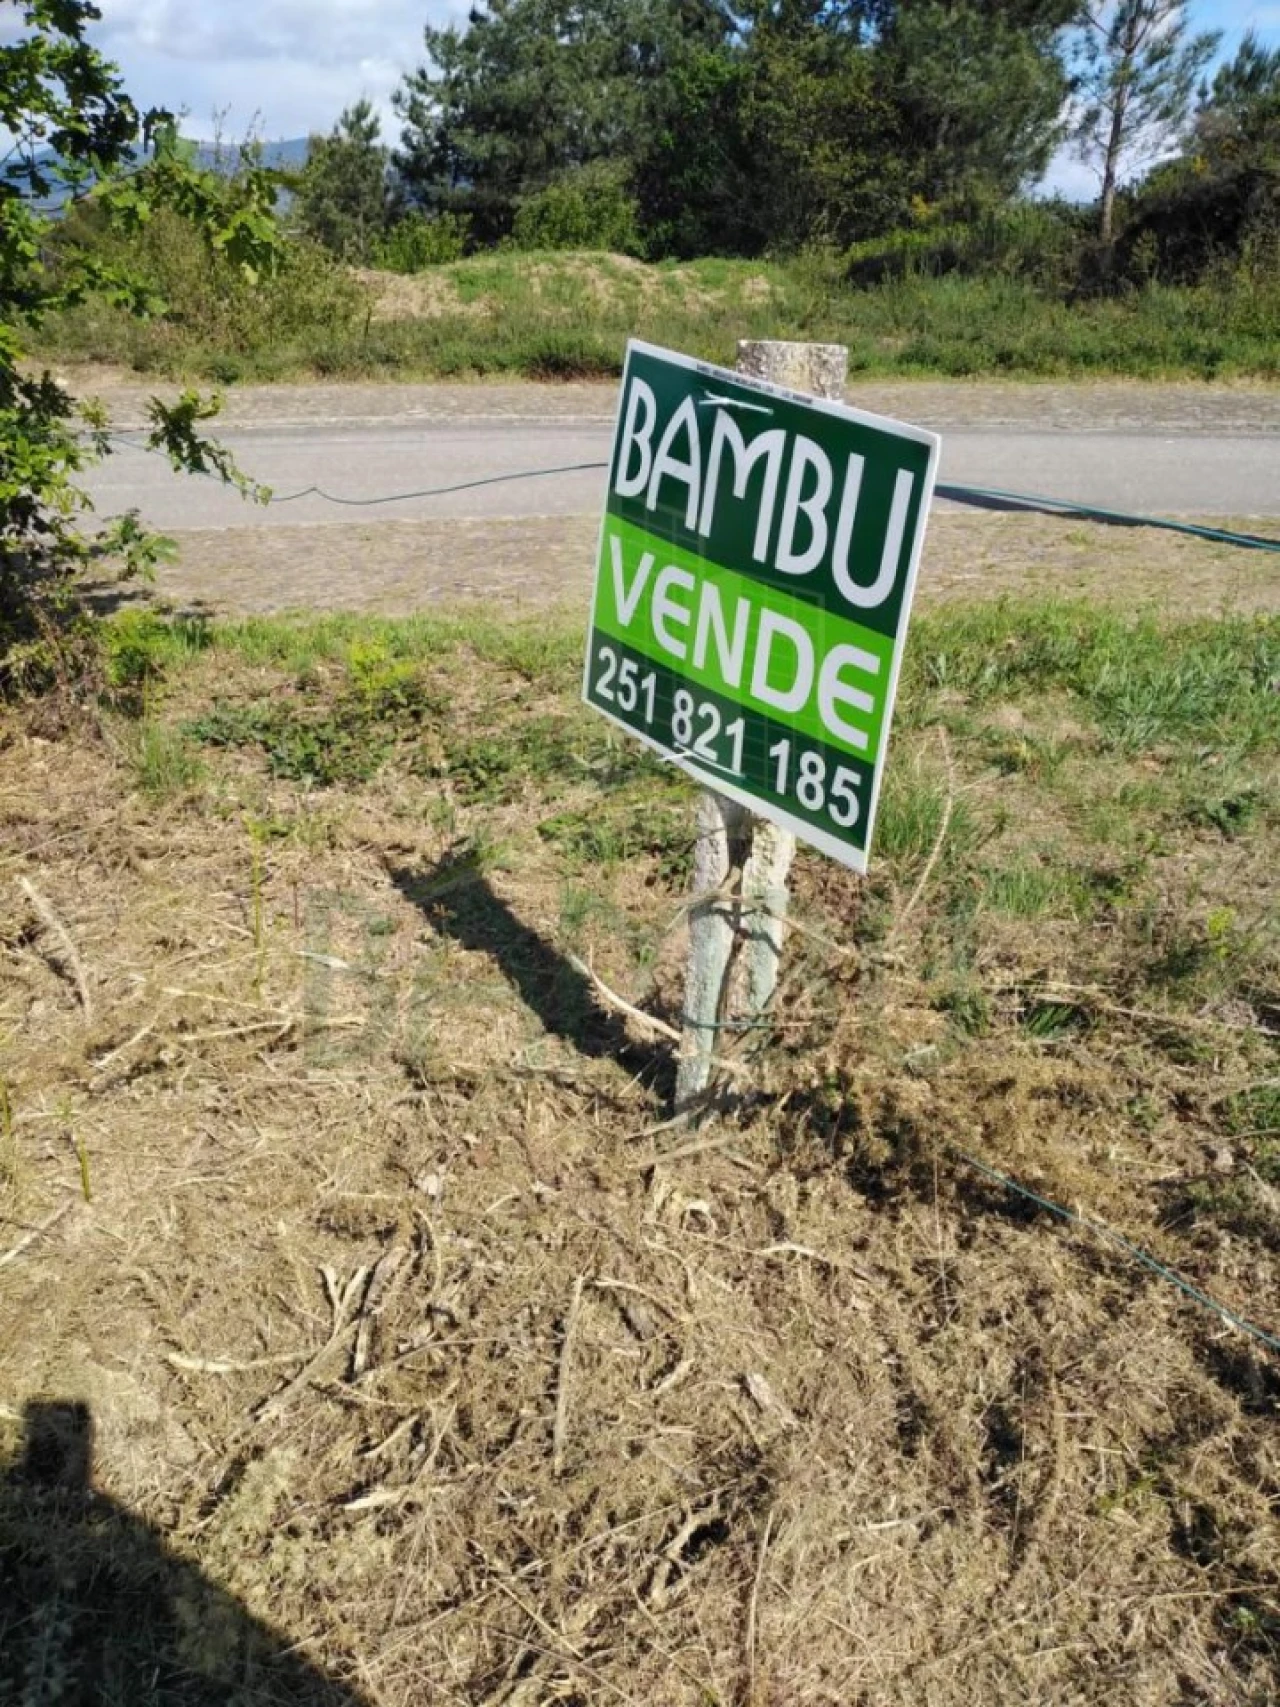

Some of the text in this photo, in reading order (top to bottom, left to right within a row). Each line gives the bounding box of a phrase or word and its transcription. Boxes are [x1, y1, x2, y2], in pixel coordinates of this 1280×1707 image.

[615, 376, 915, 609] BAMBU
[595, 646, 860, 828] 251 821 185
[609, 534, 881, 750] VENDE
